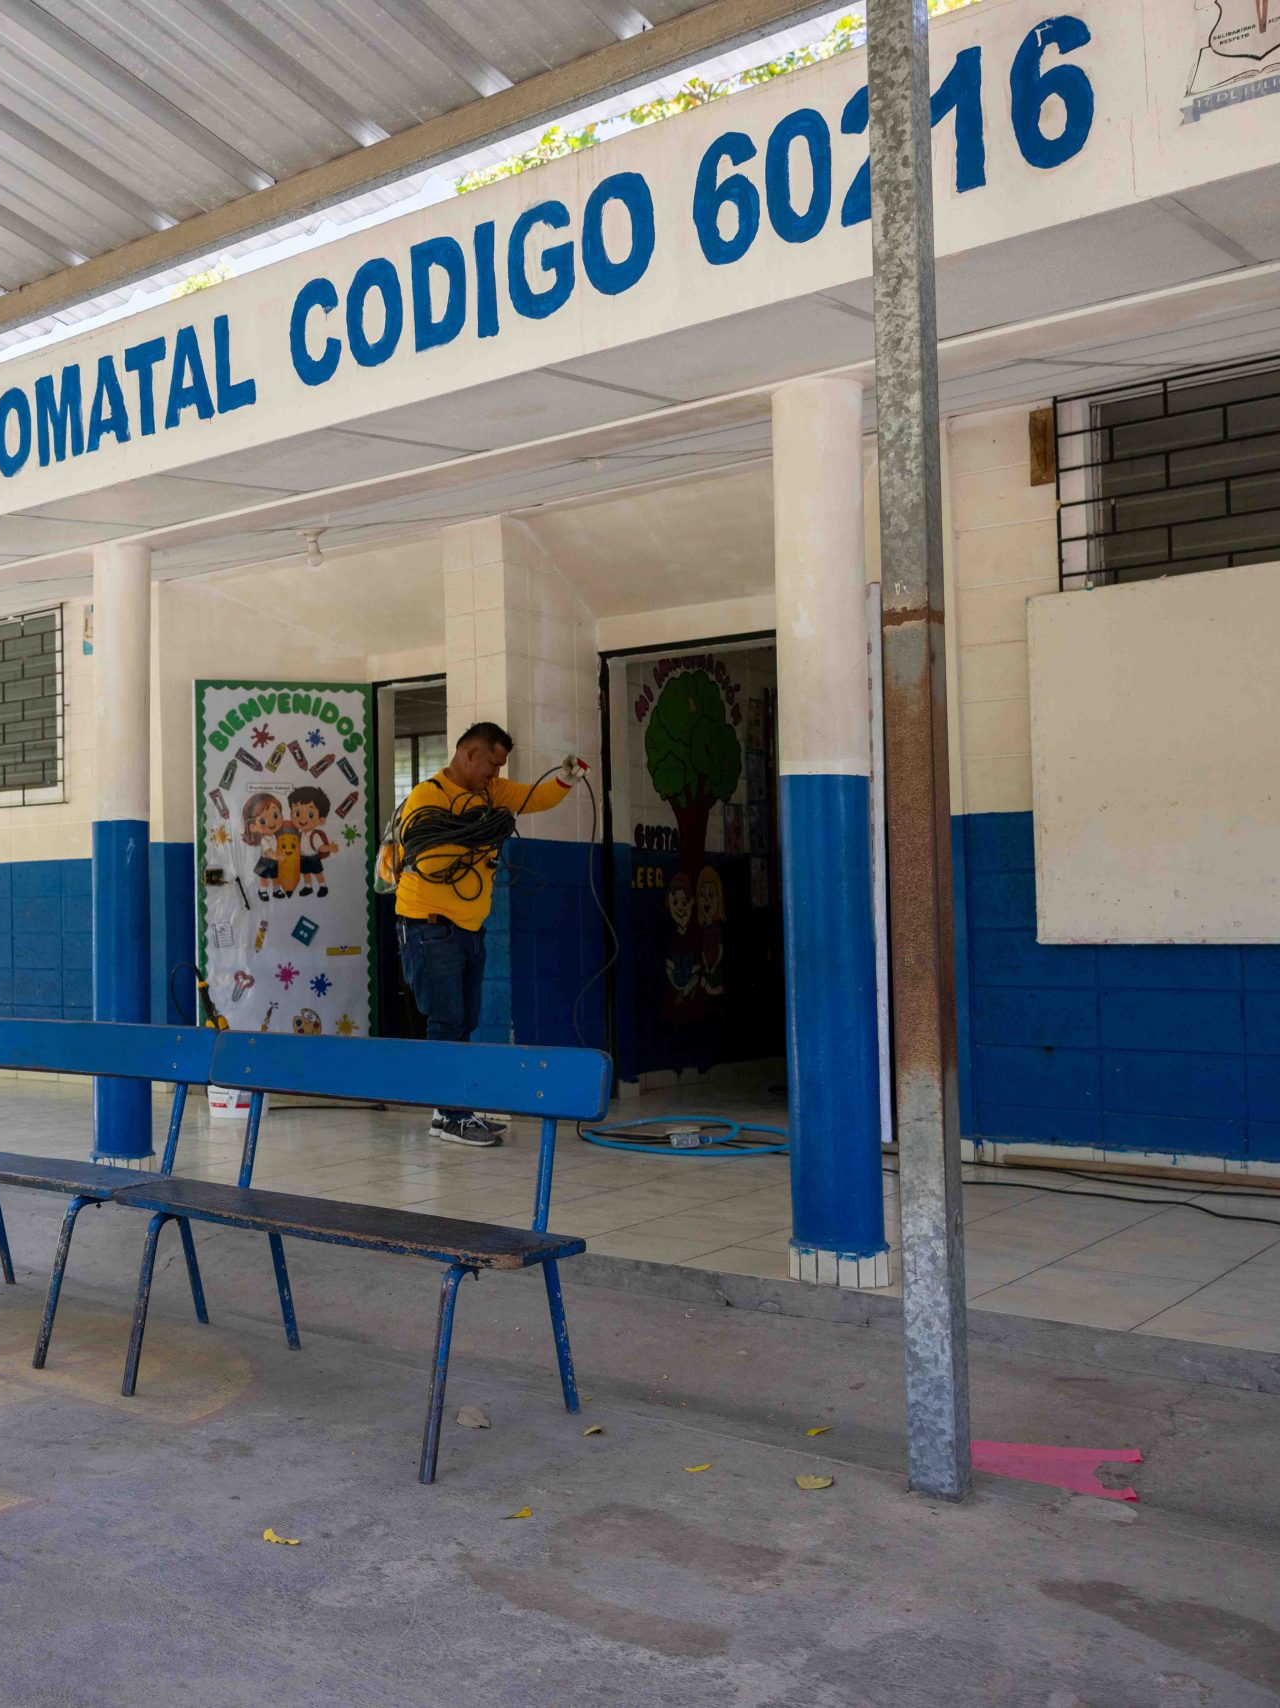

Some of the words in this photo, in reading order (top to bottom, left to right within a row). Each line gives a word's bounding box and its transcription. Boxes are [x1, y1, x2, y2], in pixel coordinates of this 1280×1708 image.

[1219, 32, 1250, 45] RESPETO
[1244, 78, 1280, 97] JULI
[289, 172, 655, 386] CODIGO
[208, 693, 364, 753] BIENVENIDOS
[631, 864, 664, 889] EER
